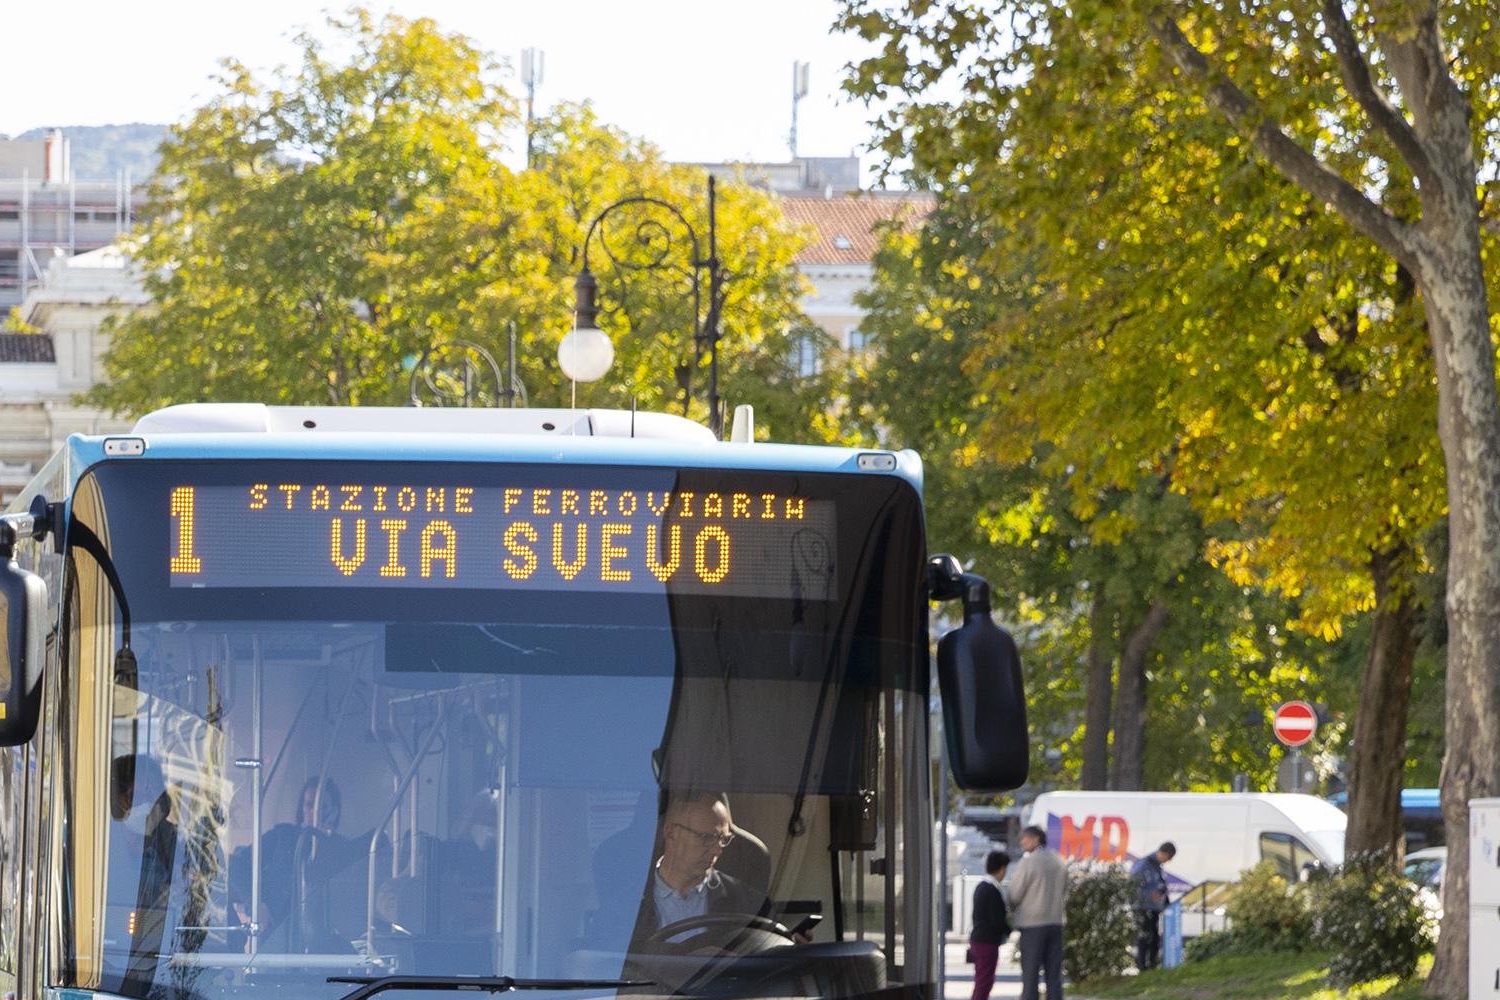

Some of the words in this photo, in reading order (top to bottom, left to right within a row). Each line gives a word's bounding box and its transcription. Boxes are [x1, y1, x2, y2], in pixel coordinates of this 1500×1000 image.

[170, 486, 201, 573] 1
[249, 483, 474, 513] STAZIONE
[502, 488, 805, 520] FERROVIARIA
[330, 517, 457, 578] VIA
[502, 520, 731, 584] SVEVO
[1060, 814, 1130, 864] MD
